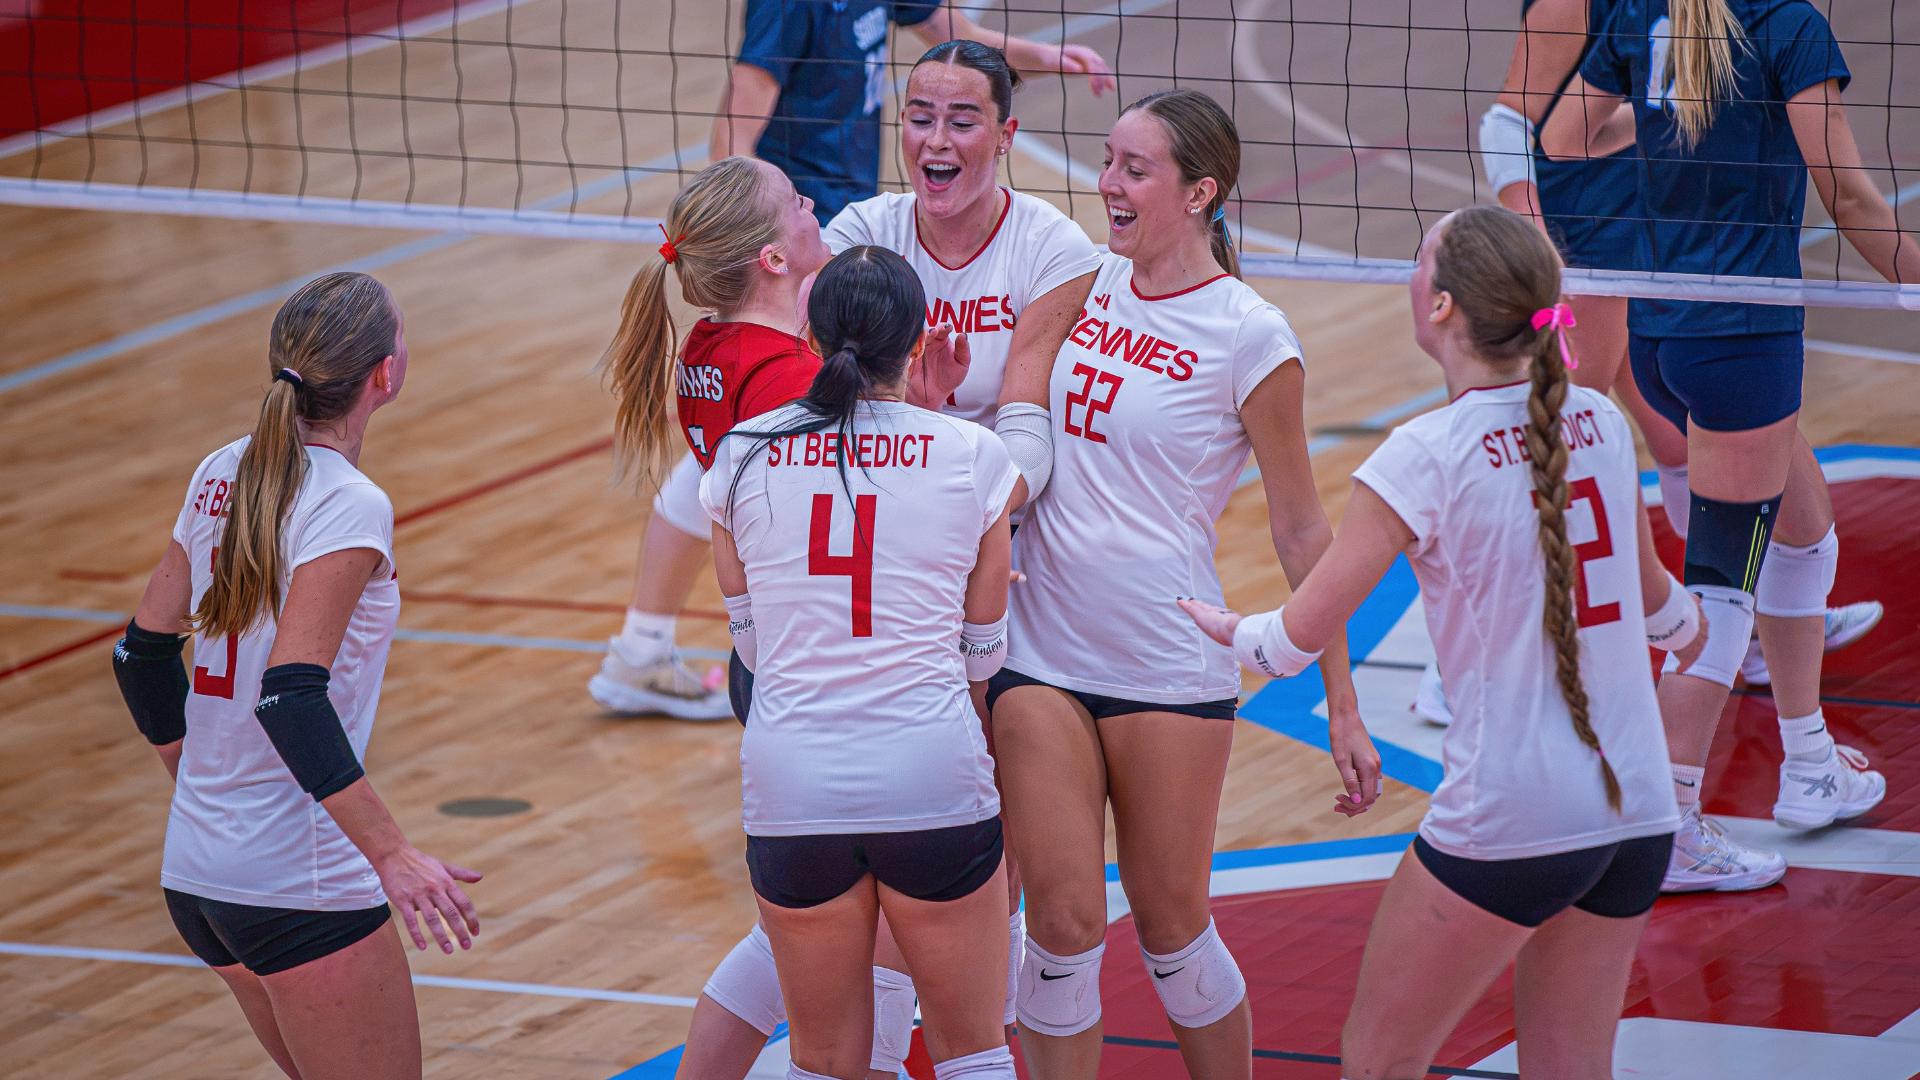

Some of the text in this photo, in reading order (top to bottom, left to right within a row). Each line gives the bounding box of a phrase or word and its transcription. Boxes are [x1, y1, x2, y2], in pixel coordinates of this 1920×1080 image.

[925, 293, 1016, 333] NNIES
[1064, 362, 1124, 444] 22
[768, 433, 935, 469] ST. BENEDICT
[1483, 410, 1604, 468] ST. BDICT
[808, 493, 878, 638] 4
